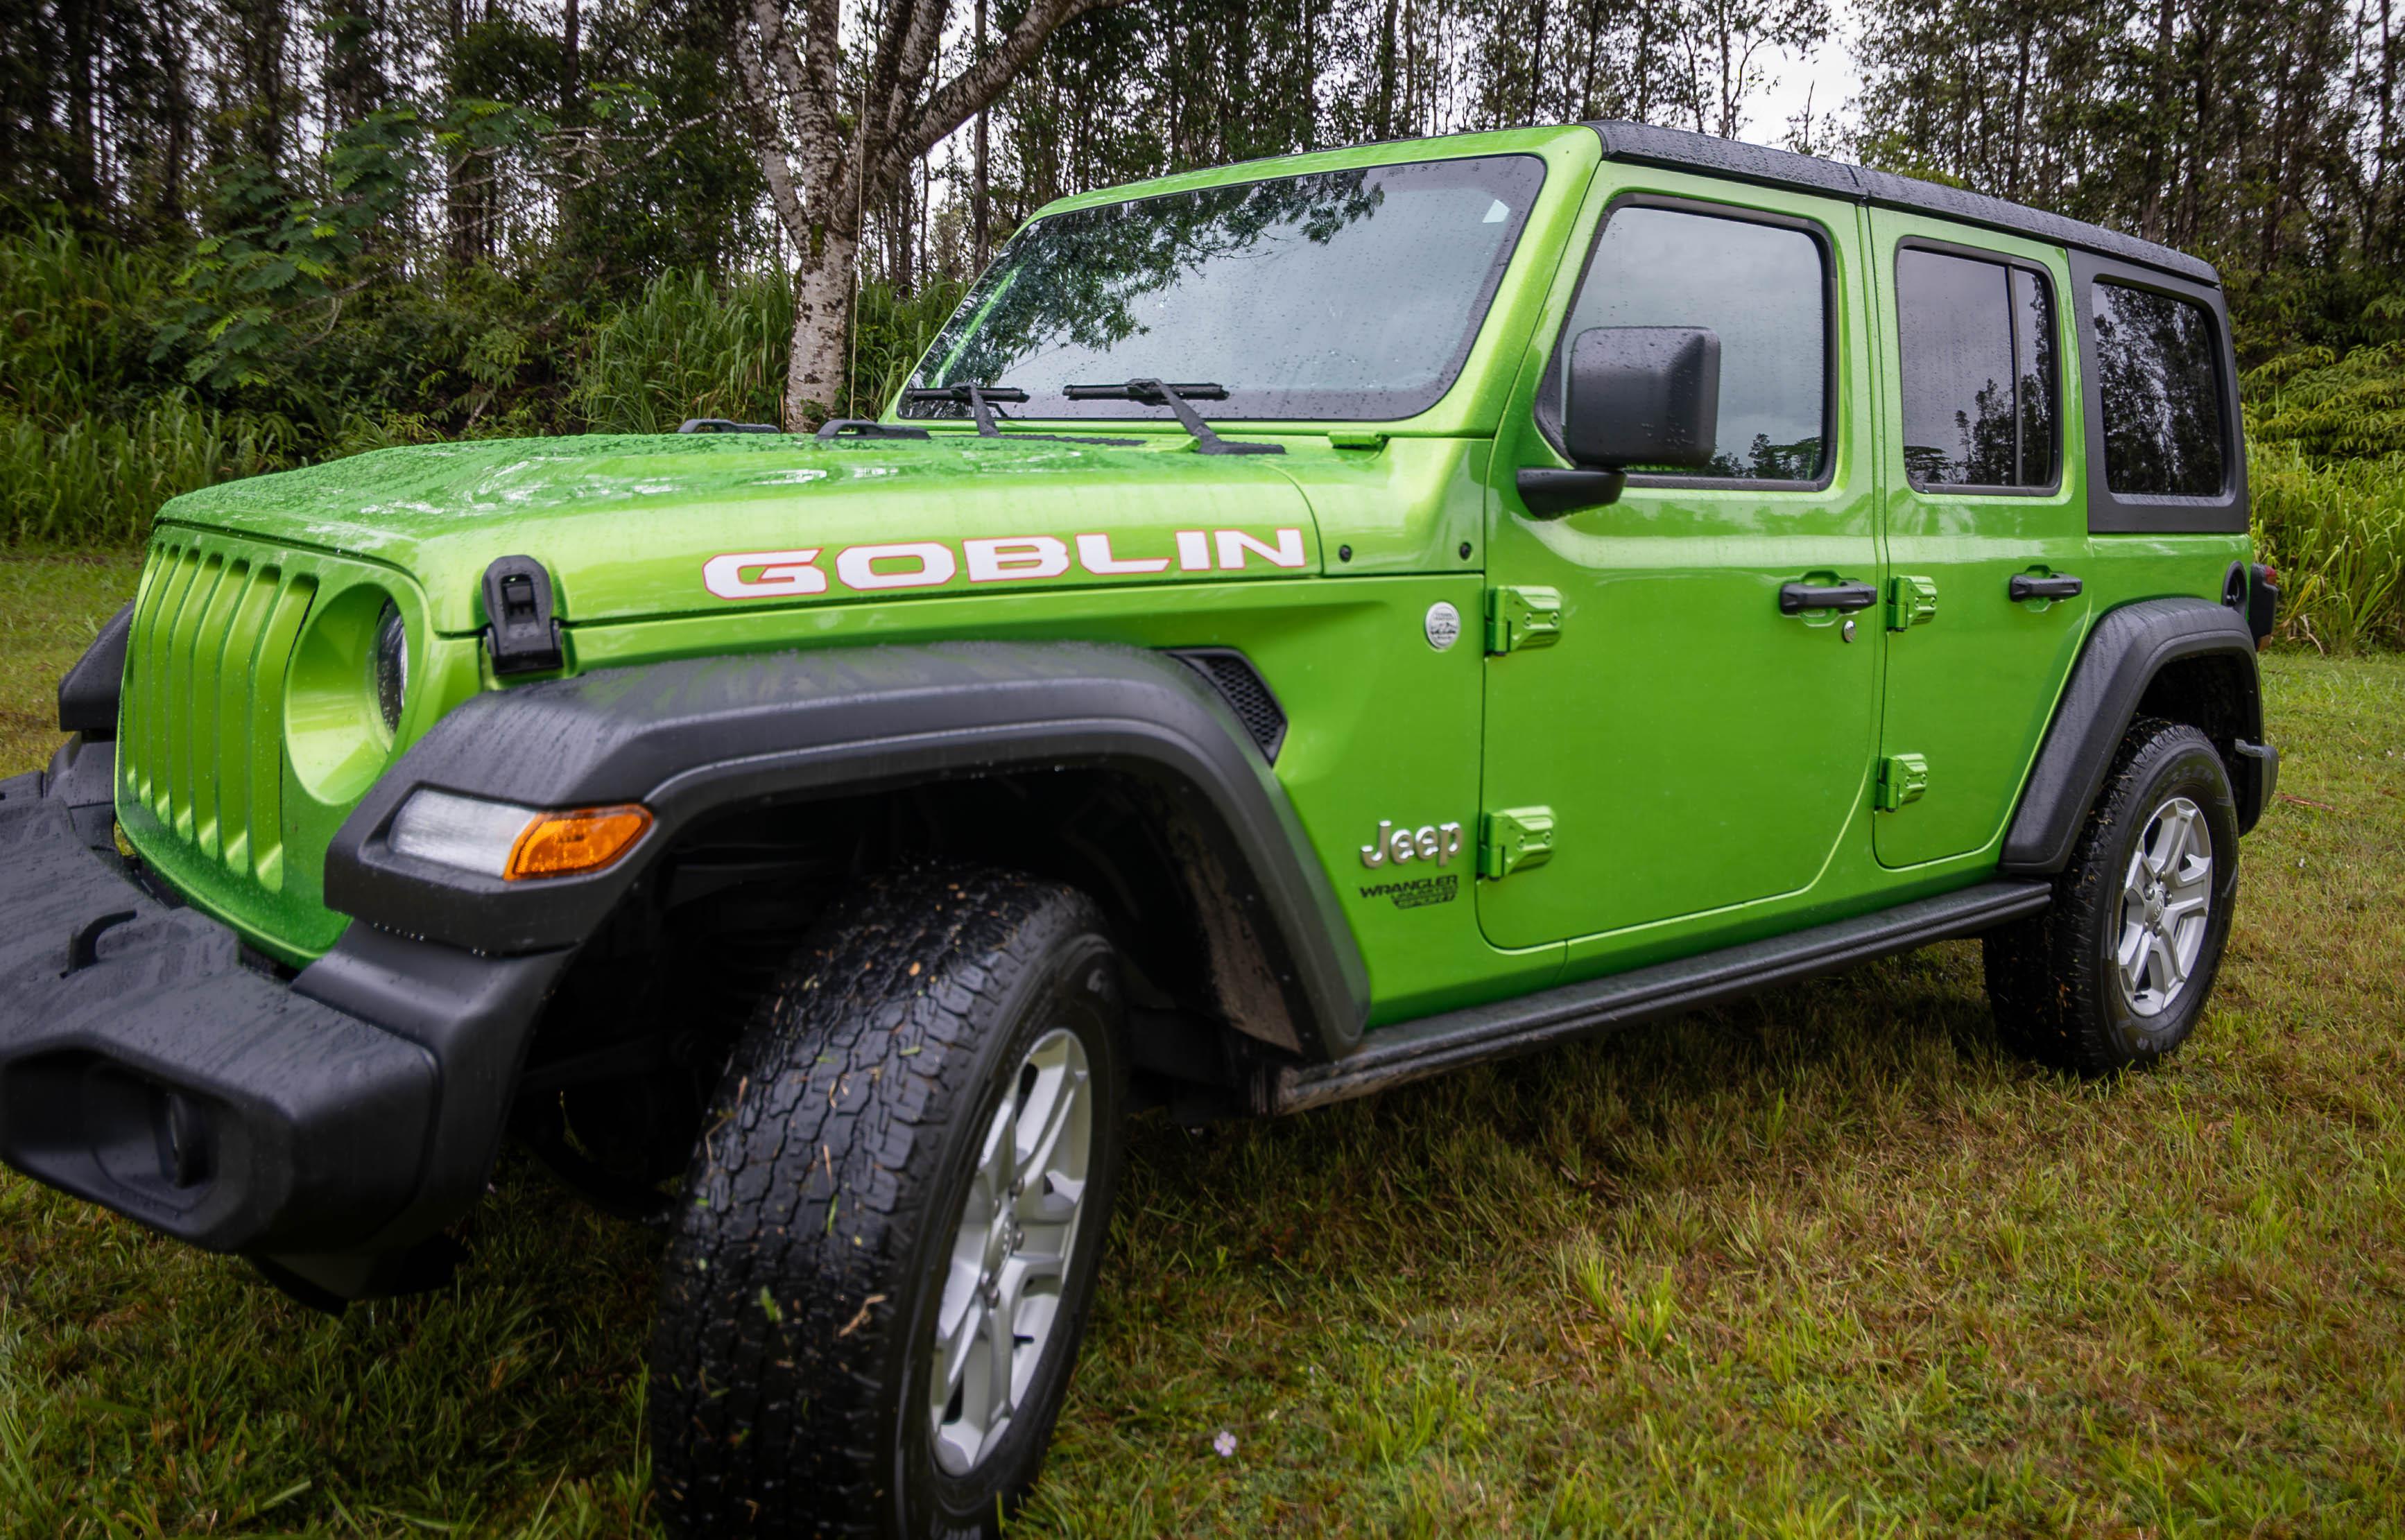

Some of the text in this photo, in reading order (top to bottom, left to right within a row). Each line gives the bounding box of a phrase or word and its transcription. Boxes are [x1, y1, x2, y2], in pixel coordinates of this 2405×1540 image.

[702, 528, 1306, 600] GOBLIN
[1360, 820, 1463, 868] Jeep
[1359, 874, 1458, 899] WRANGLER
